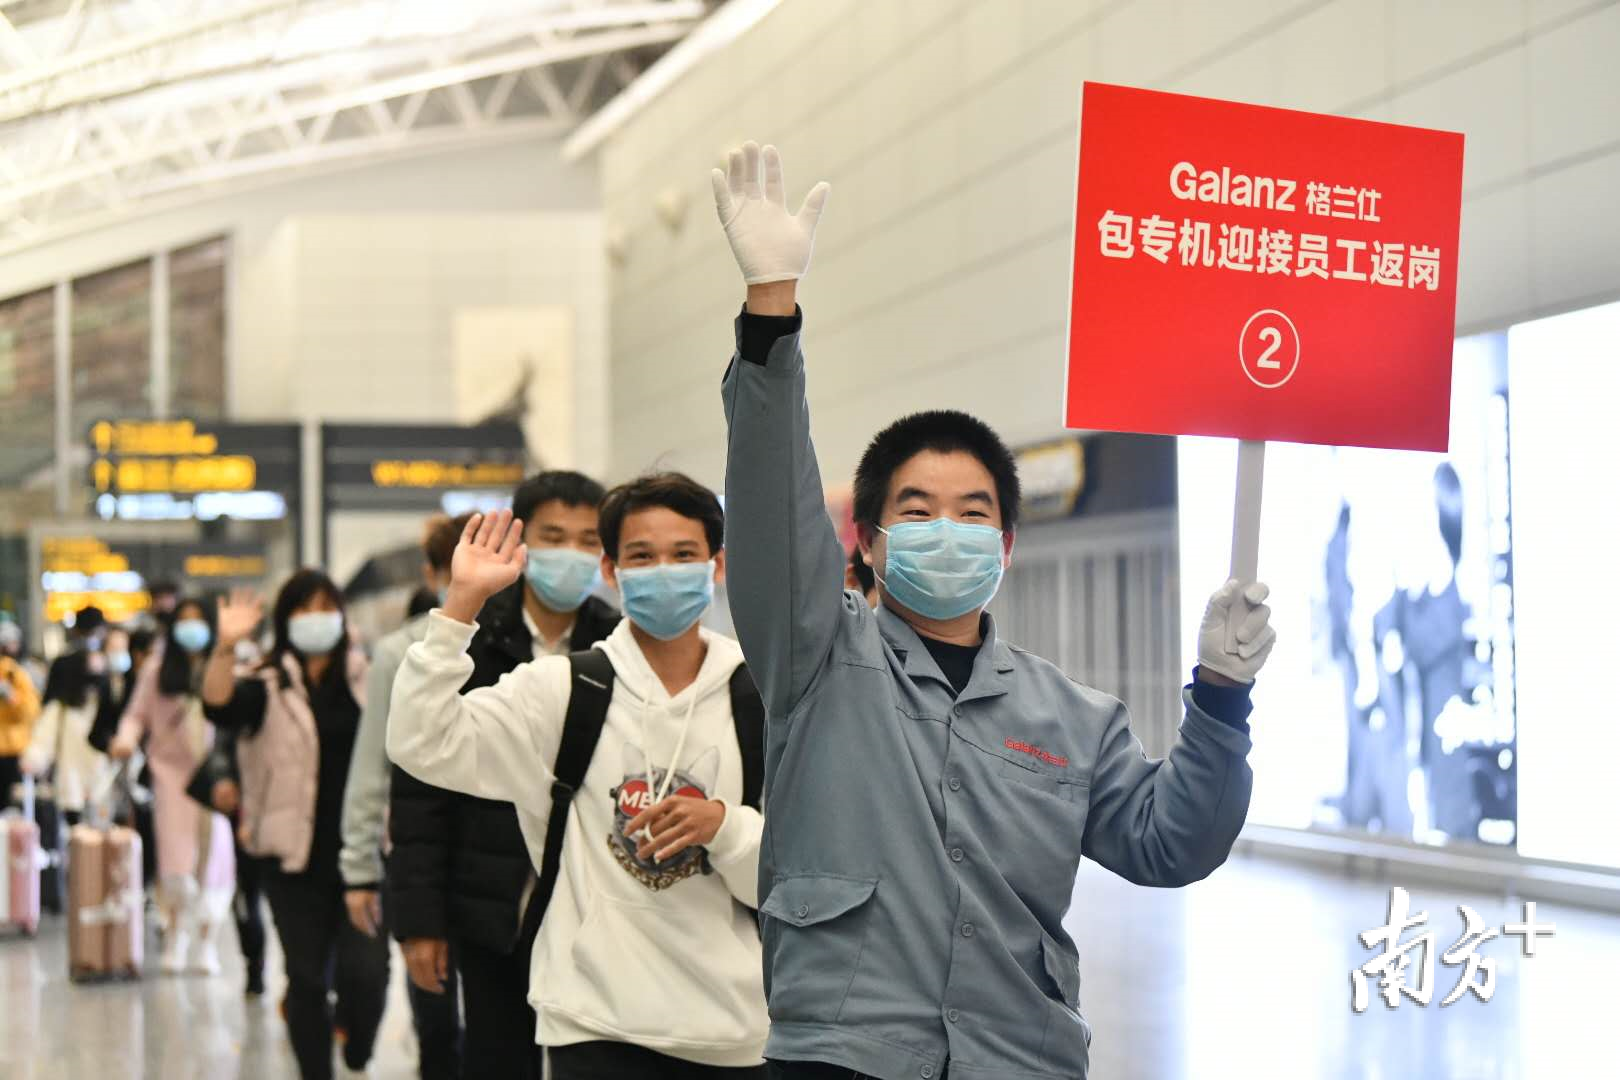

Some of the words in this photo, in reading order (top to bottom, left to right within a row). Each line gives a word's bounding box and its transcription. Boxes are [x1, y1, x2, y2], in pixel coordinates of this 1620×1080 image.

[1169, 161, 1296, 212] Galanz
[1305, 182, 1382, 222] 格兰仕
[1098, 209, 1441, 291] 包专机迎接员工返岗
[1256, 327, 1282, 369] 2
